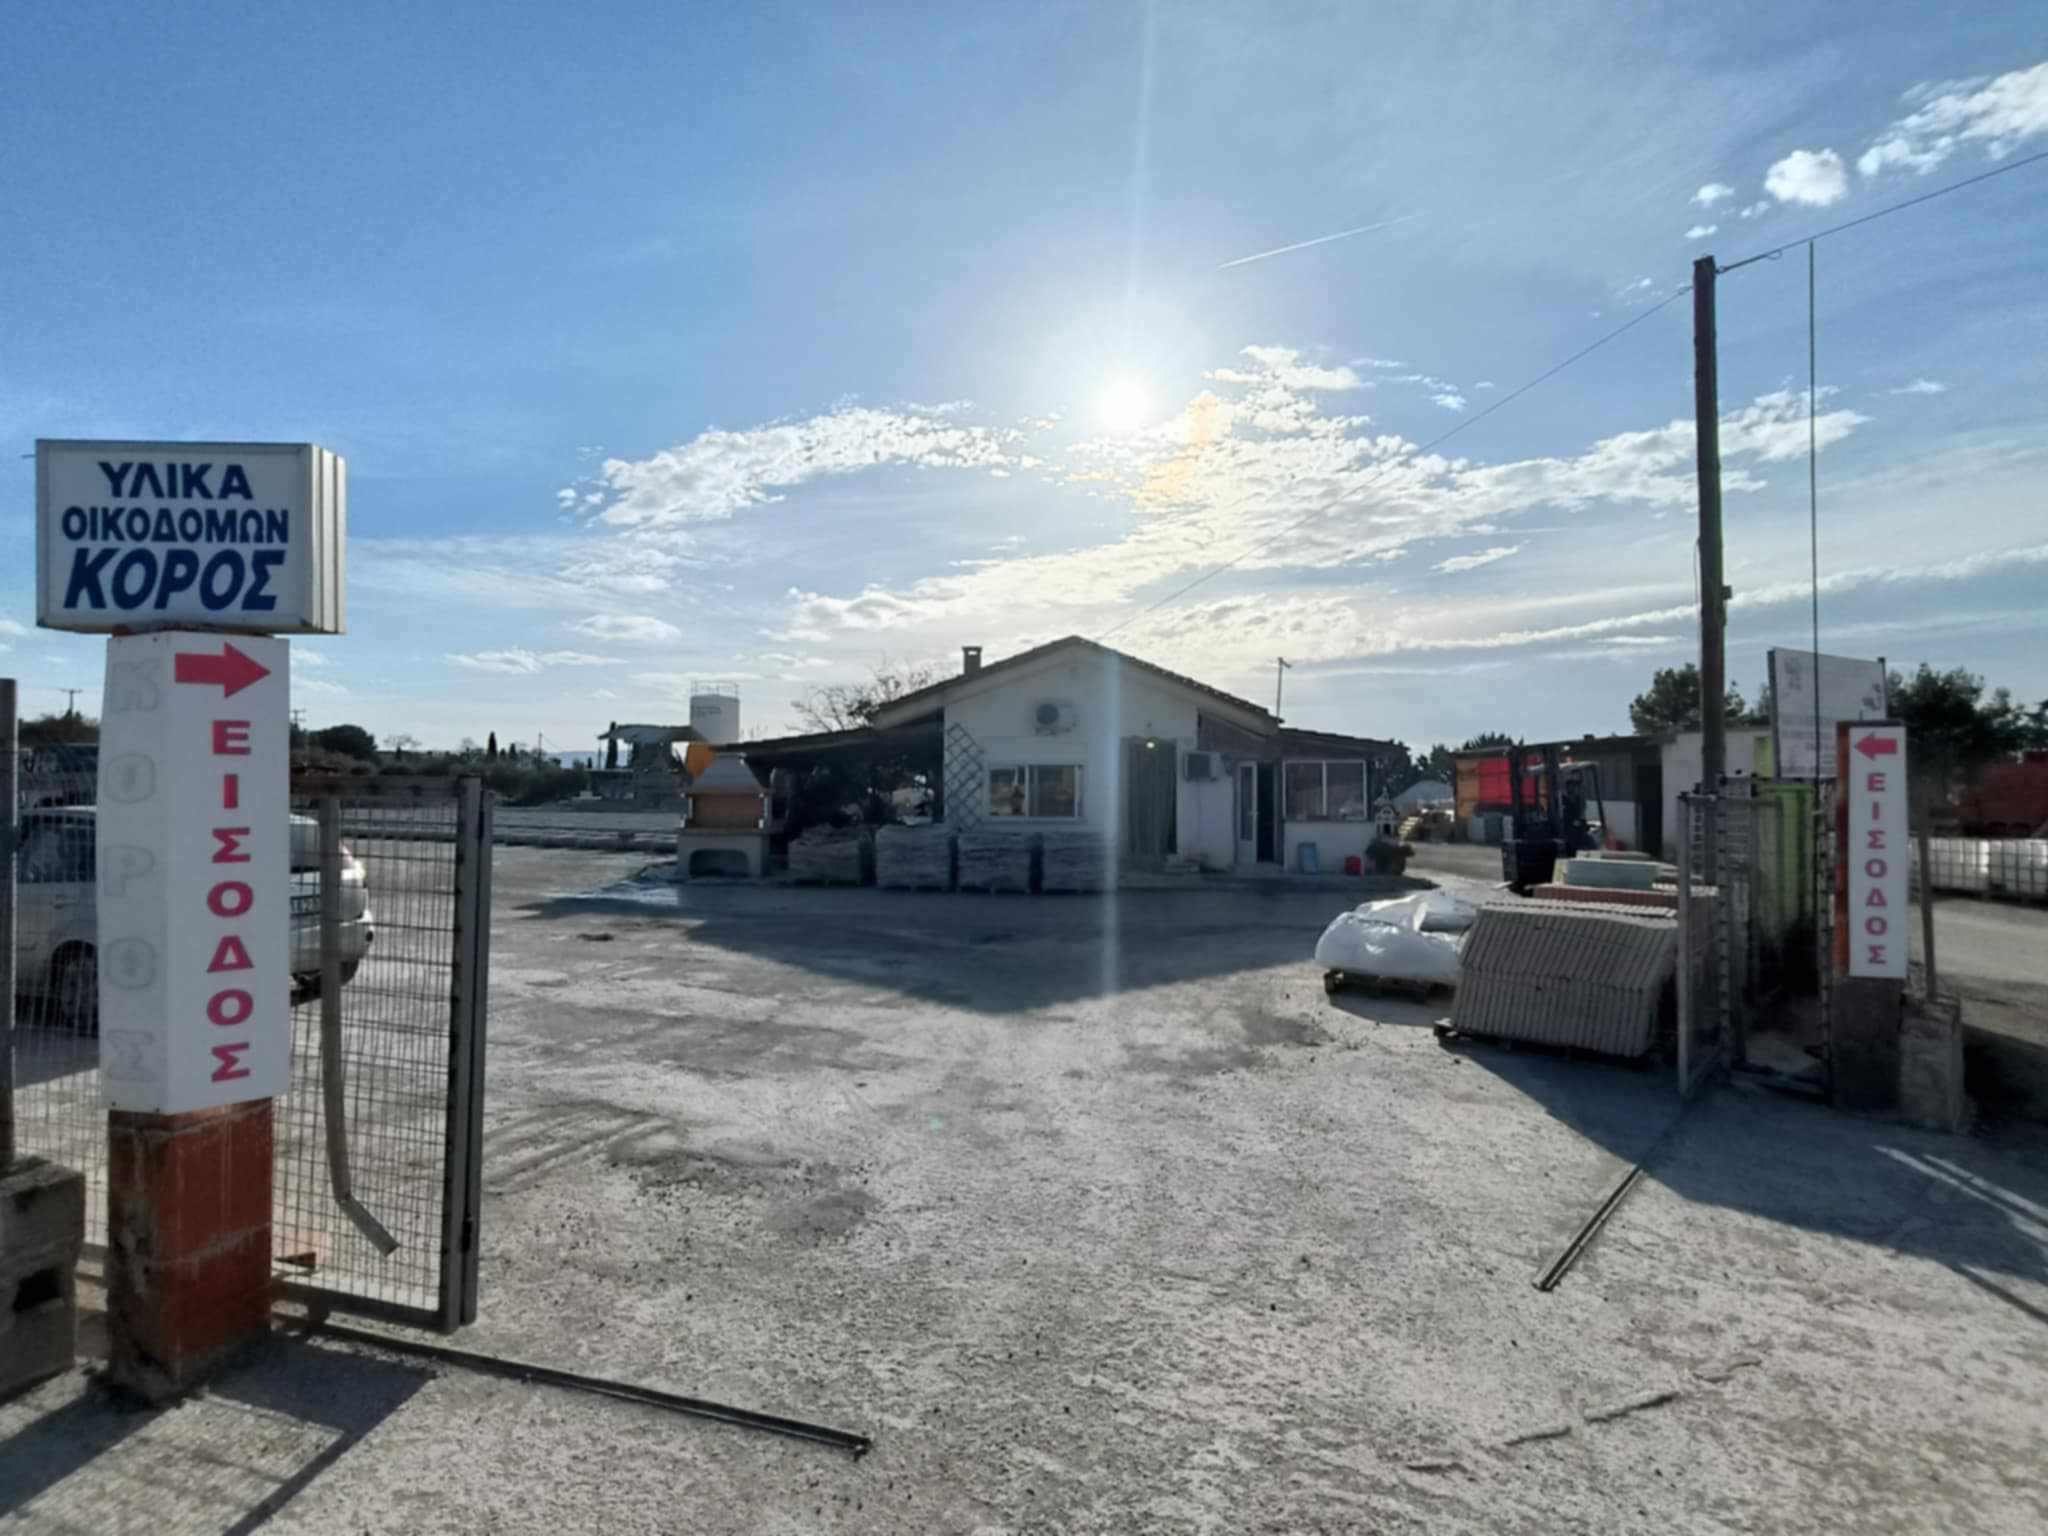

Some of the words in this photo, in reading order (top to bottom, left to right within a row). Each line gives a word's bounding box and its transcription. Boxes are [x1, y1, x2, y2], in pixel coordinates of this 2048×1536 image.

[98, 462, 253, 499] ΥΛΙΚΑ
[62, 506, 289, 544] ΟΙΚΟΔΟΜΩΝ
[64, 547, 286, 611] ΚΟΡΟΣ
[1865, 772, 1888, 965] ΕΙΣΟΔΟΣ
[207, 720, 253, 1083] ΕΙΣΟΔΟΣ
